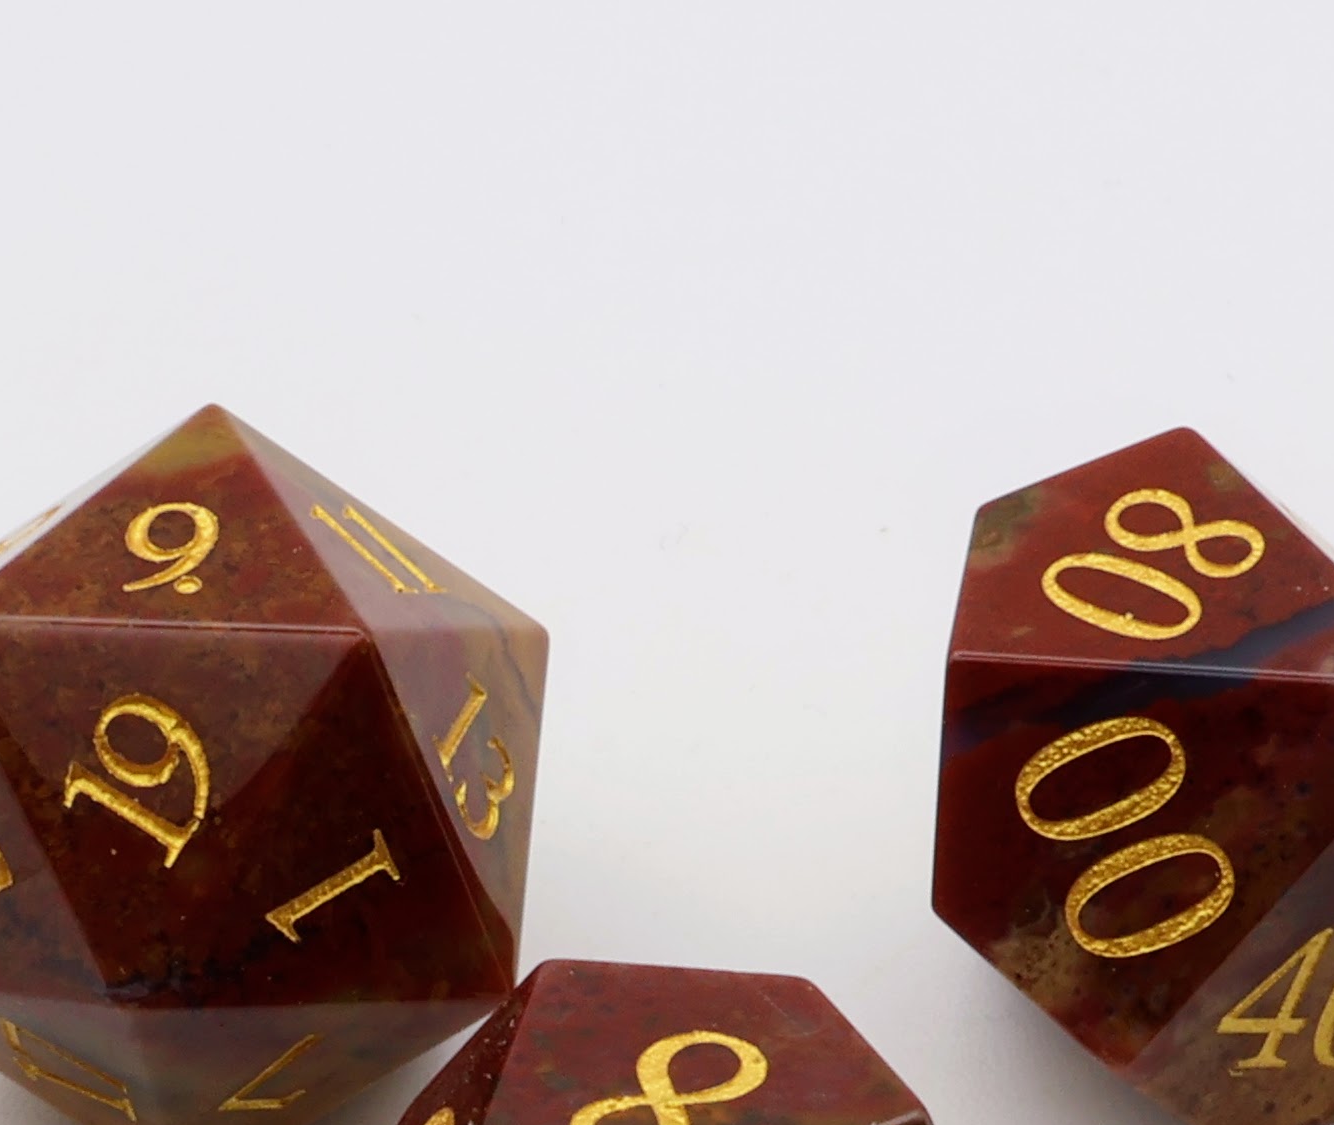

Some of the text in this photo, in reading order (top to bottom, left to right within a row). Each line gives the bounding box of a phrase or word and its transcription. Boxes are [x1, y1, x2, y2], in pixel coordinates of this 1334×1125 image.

[64, 694, 209, 868] 19
[432, 671, 515, 840] 13
[1015, 716, 1235, 958] 00
[266, 829, 400, 943] 1
